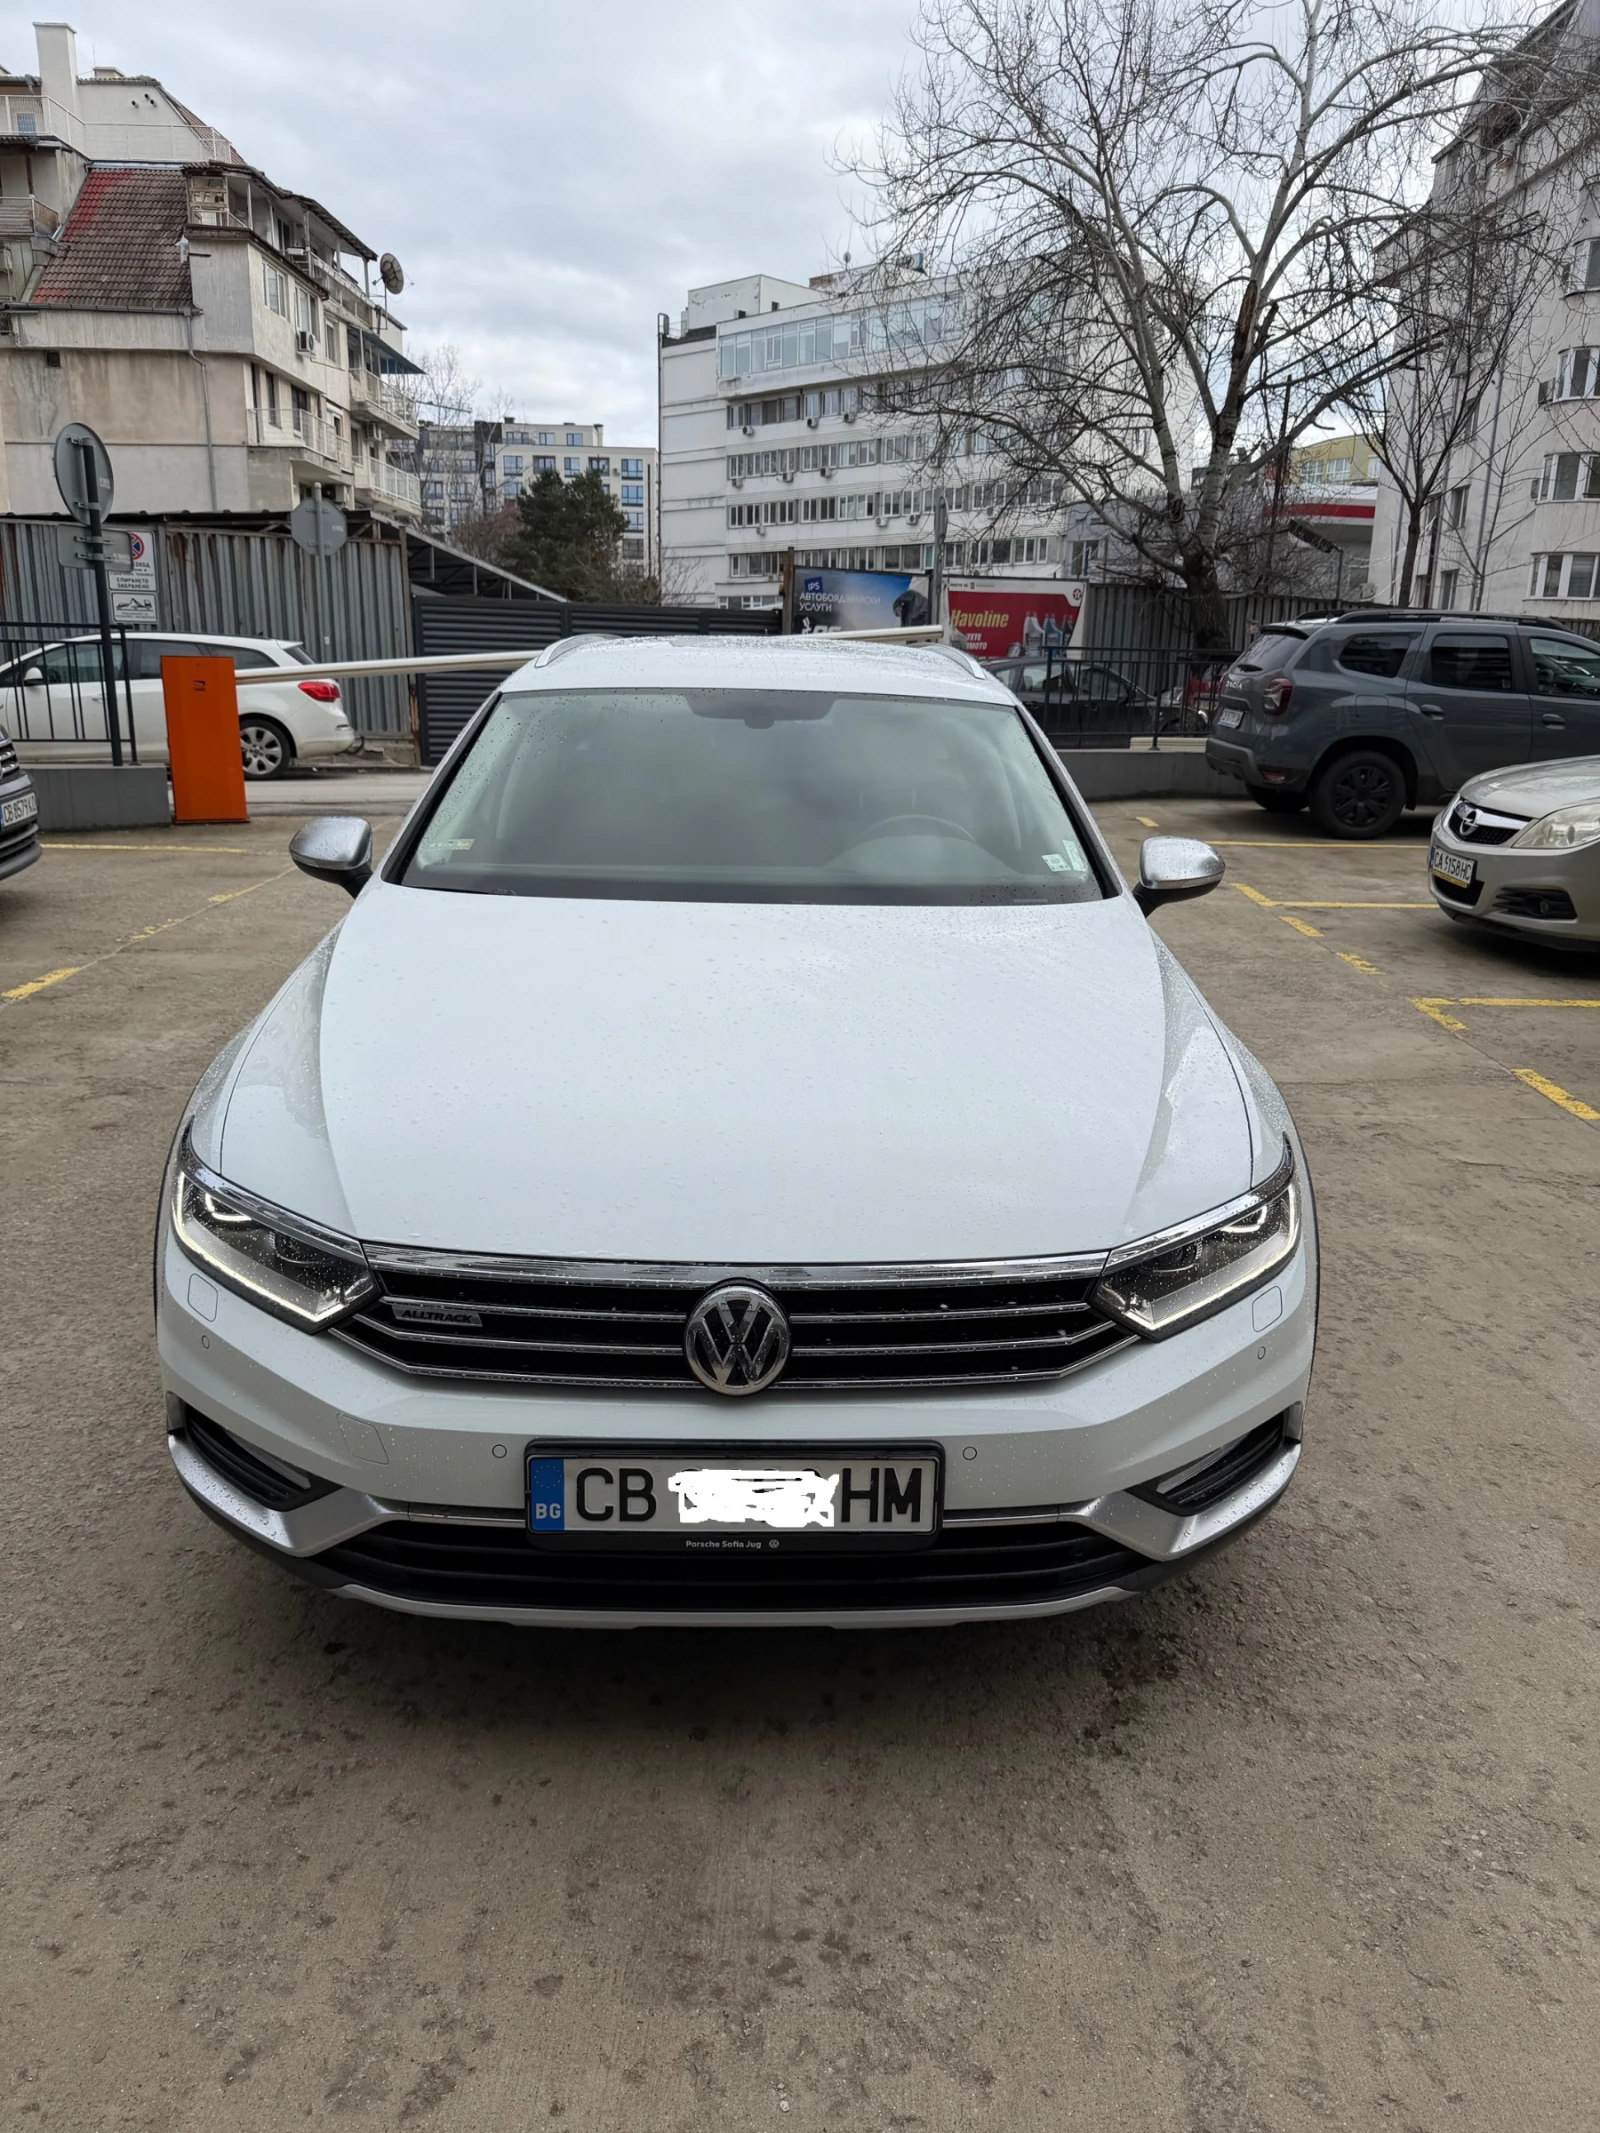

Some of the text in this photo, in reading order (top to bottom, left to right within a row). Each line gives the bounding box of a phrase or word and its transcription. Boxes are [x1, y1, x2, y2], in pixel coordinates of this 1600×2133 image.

[807, 582, 820, 591] IPS
[799, 593, 880, 604] АВТОБОЯДЖИЙСКИ
[799, 602, 832, 612] УСЛУГИ
[950, 609, 1009, 628] Havoline
[401, 1309, 473, 1323] ALLTRACK
[576, 1467, 657, 1522] CB
[840, 1467, 922, 1523] HM
[535, 1503, 562, 1519] BG
[685, 1540, 720, 1548] Porsche
[722, 1540, 744, 1548] Sofia
[746, 1540, 761, 1549] Jug
